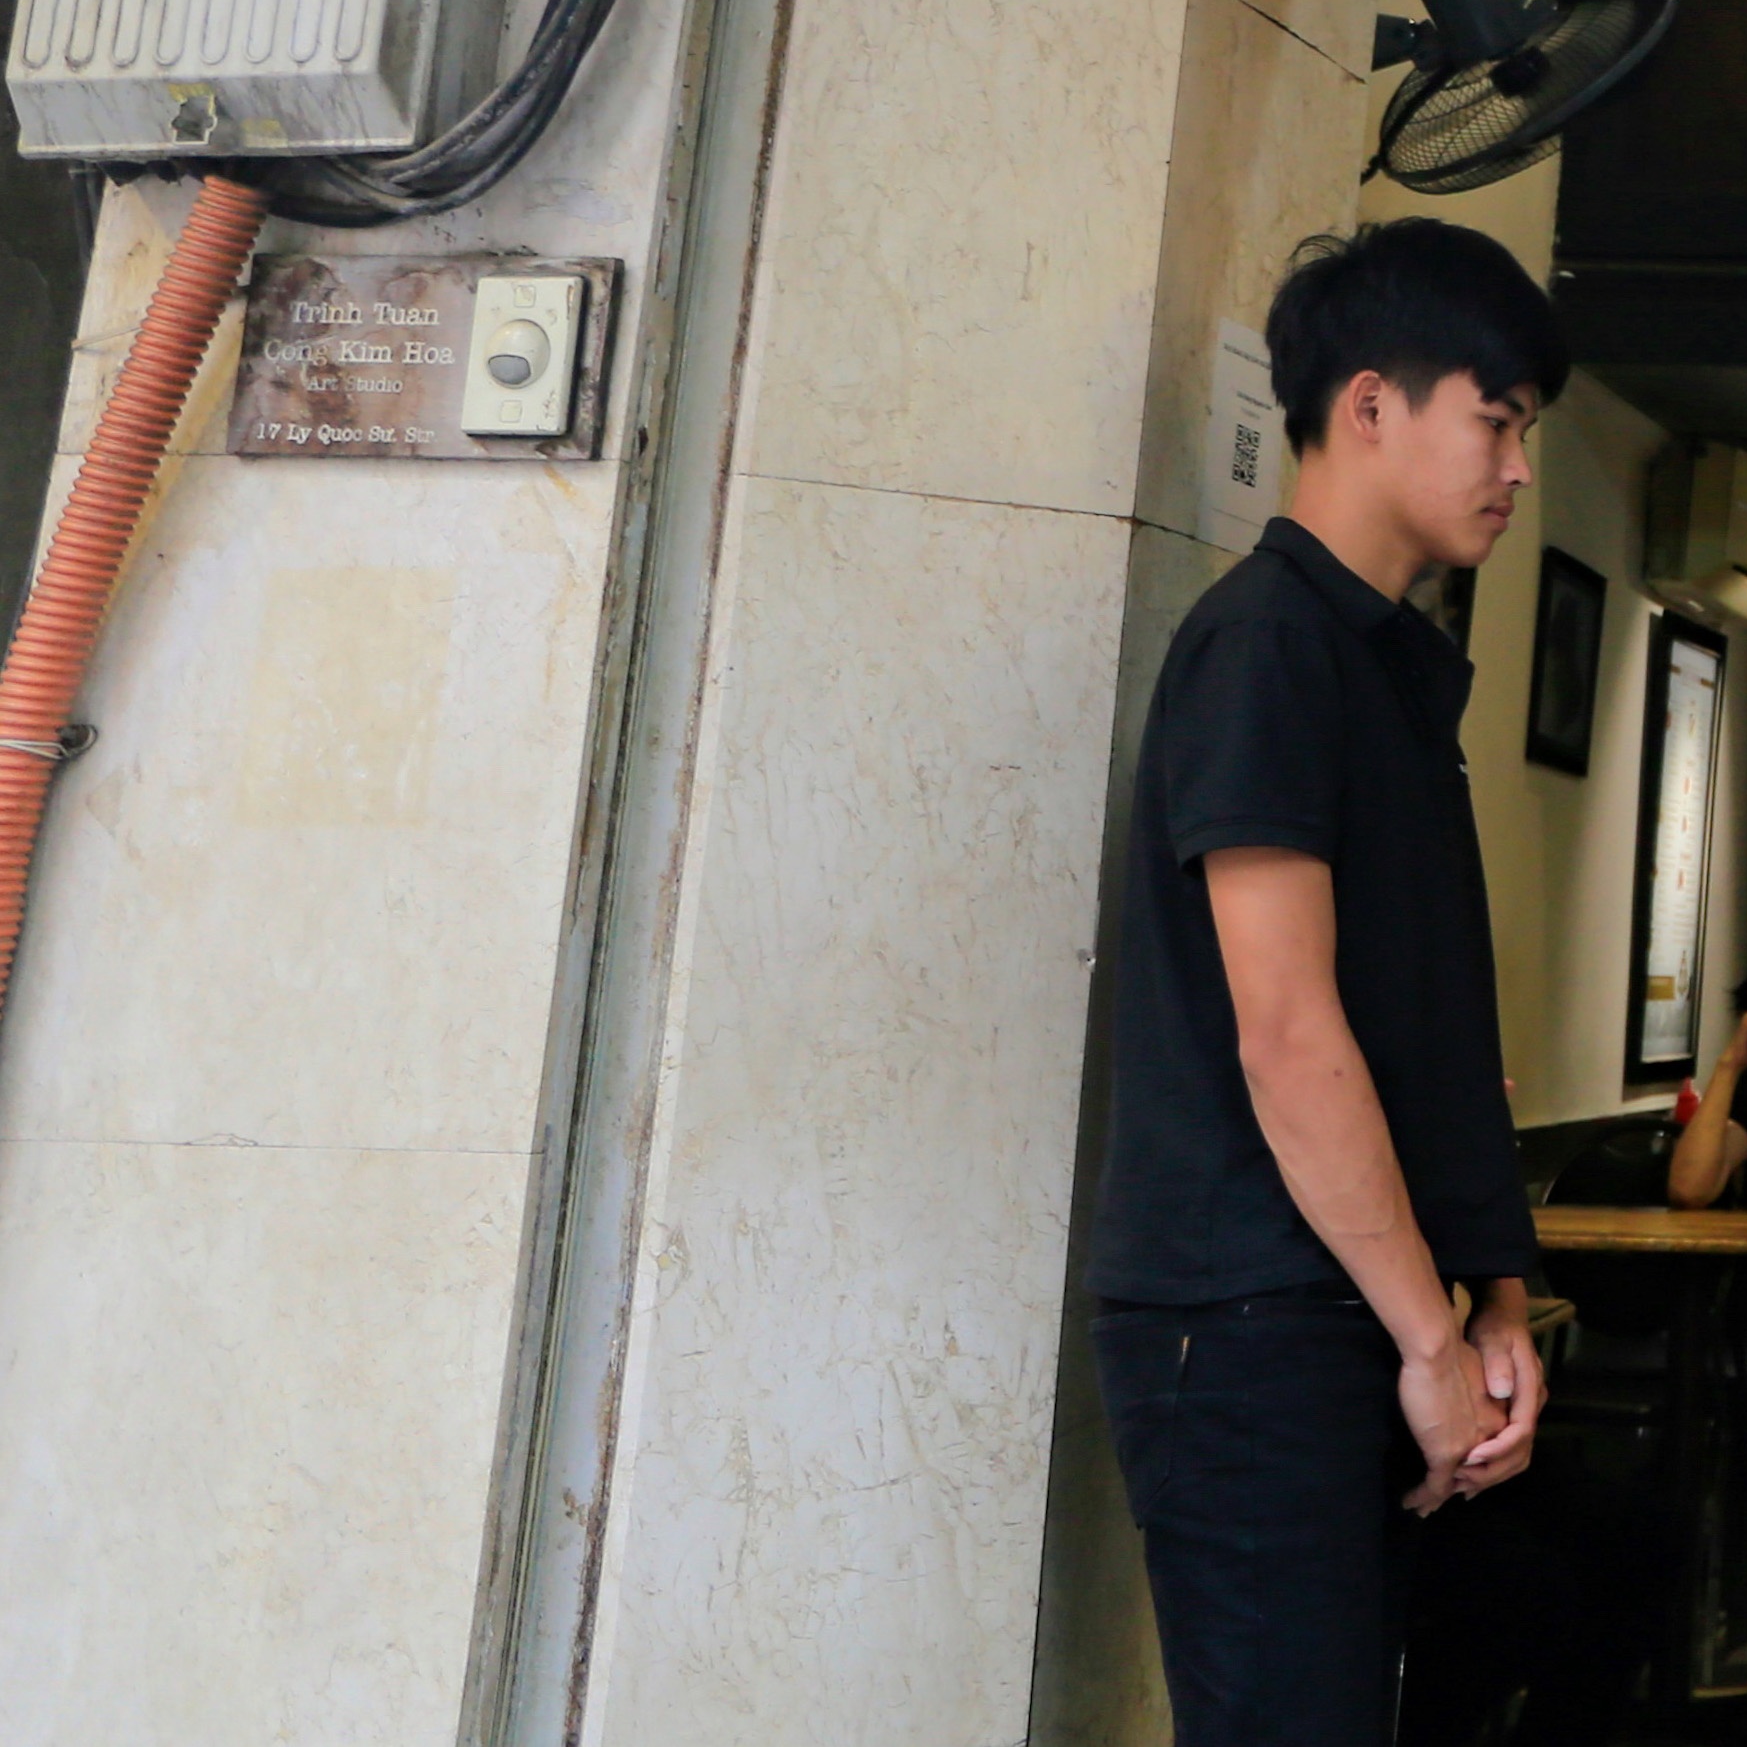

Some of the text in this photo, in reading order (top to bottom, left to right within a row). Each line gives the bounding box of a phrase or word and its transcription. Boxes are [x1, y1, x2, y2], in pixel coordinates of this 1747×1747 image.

[290, 302, 439, 325] Trinh Tuan
[264, 339, 455, 367] Cong Kim Hoa
[307, 375, 403, 393] Art Studio
[255, 424, 281, 440] 17
[287, 424, 312, 443] Ly
[317, 426, 363, 443] Quoc
